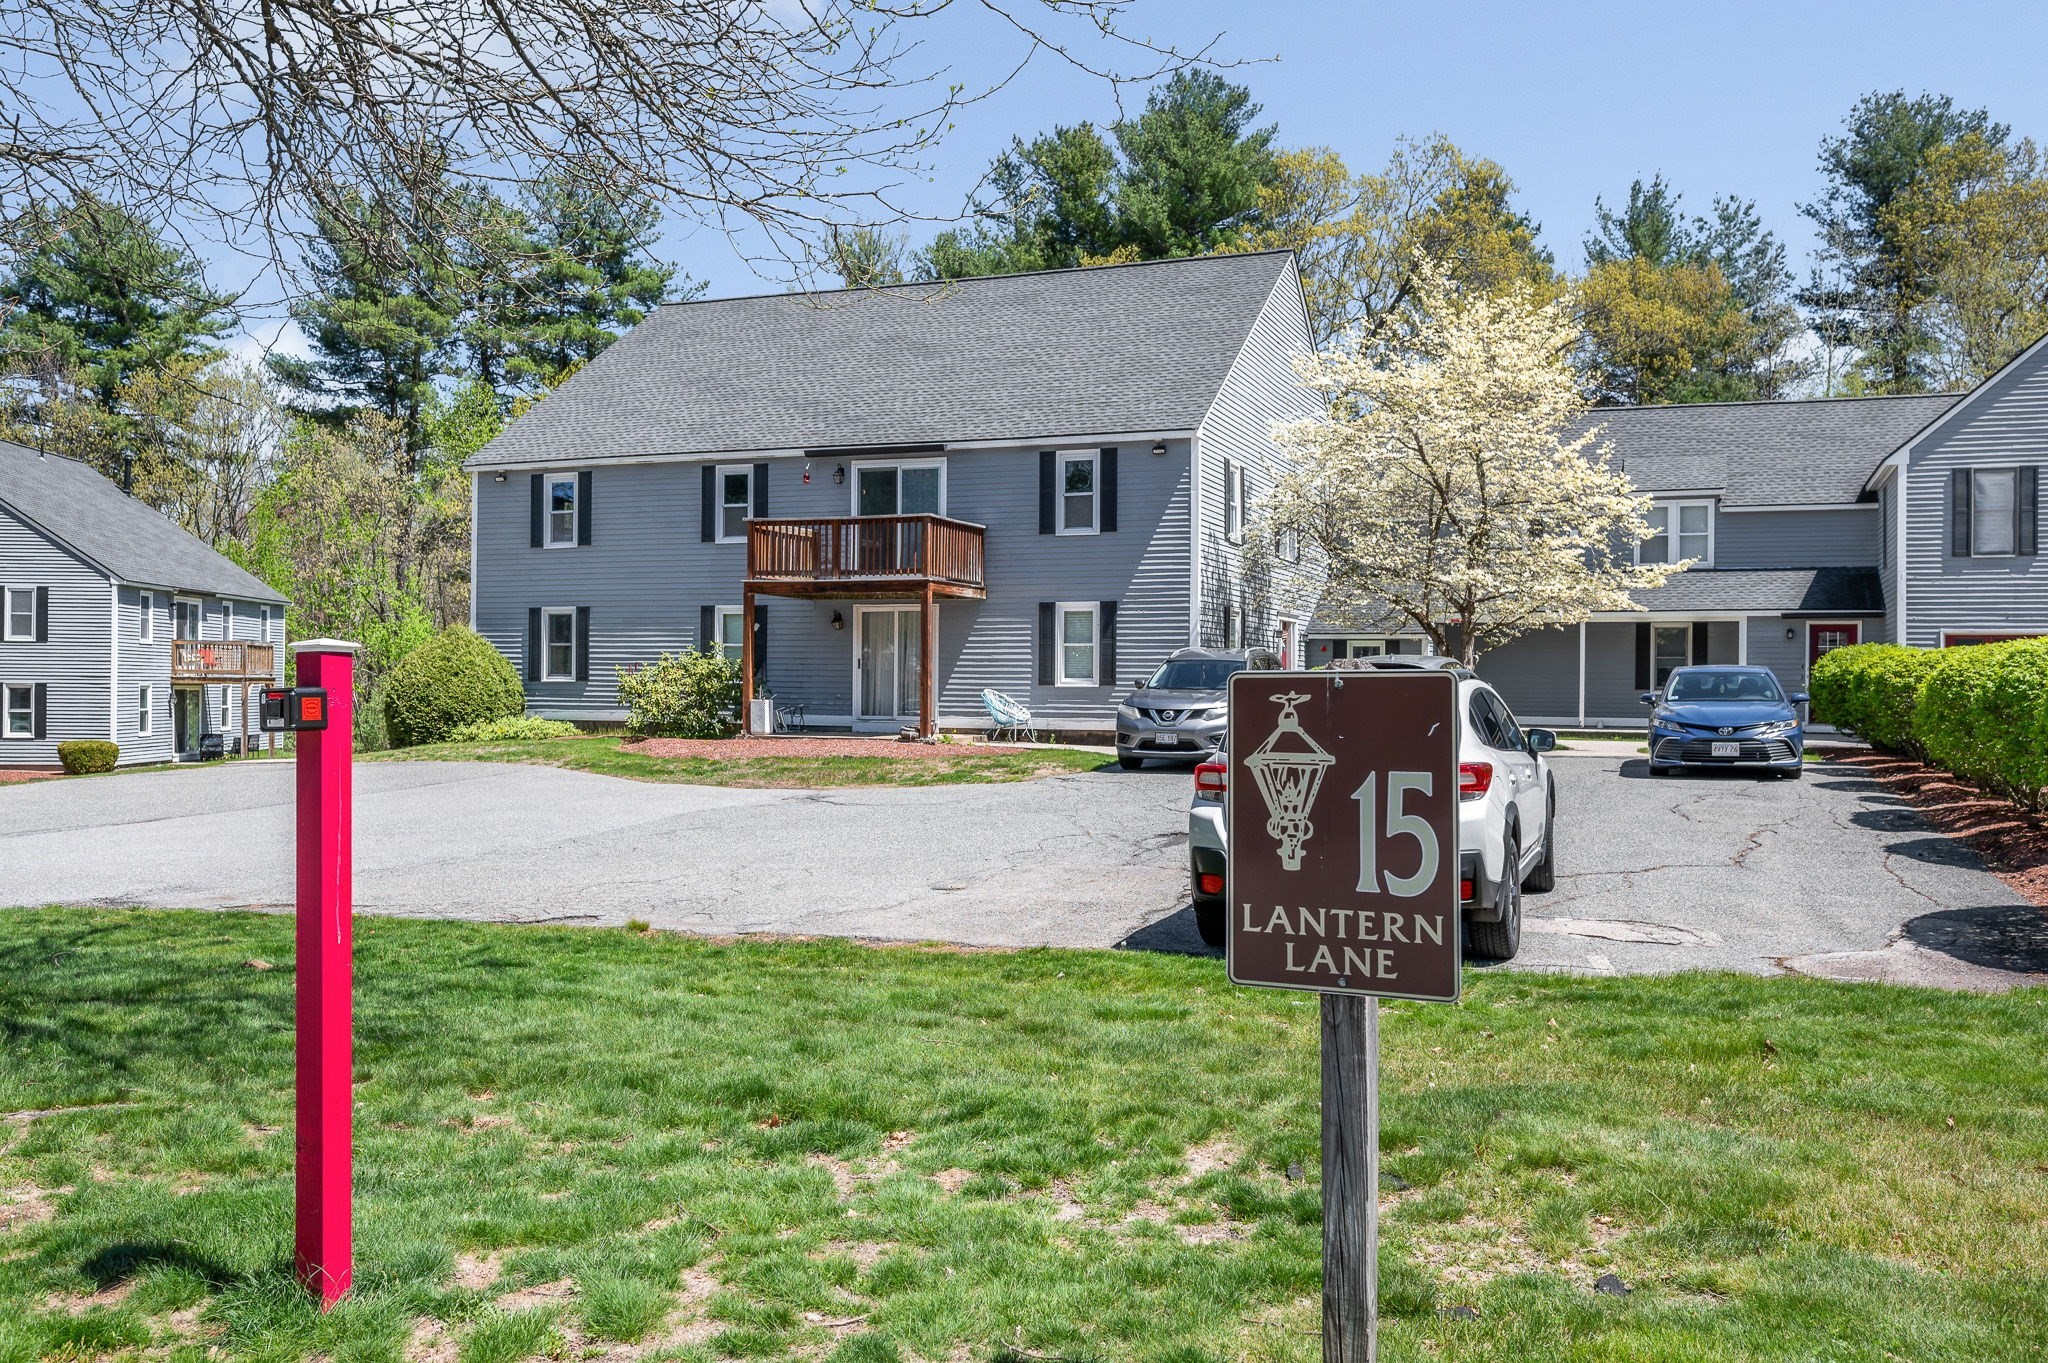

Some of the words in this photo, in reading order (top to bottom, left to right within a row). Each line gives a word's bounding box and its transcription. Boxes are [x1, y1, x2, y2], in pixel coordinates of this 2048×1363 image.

[1351, 770, 1440, 898] 15
[1242, 904, 1444, 946] LANTERN
[1285, 943, 1398, 979] LANE
